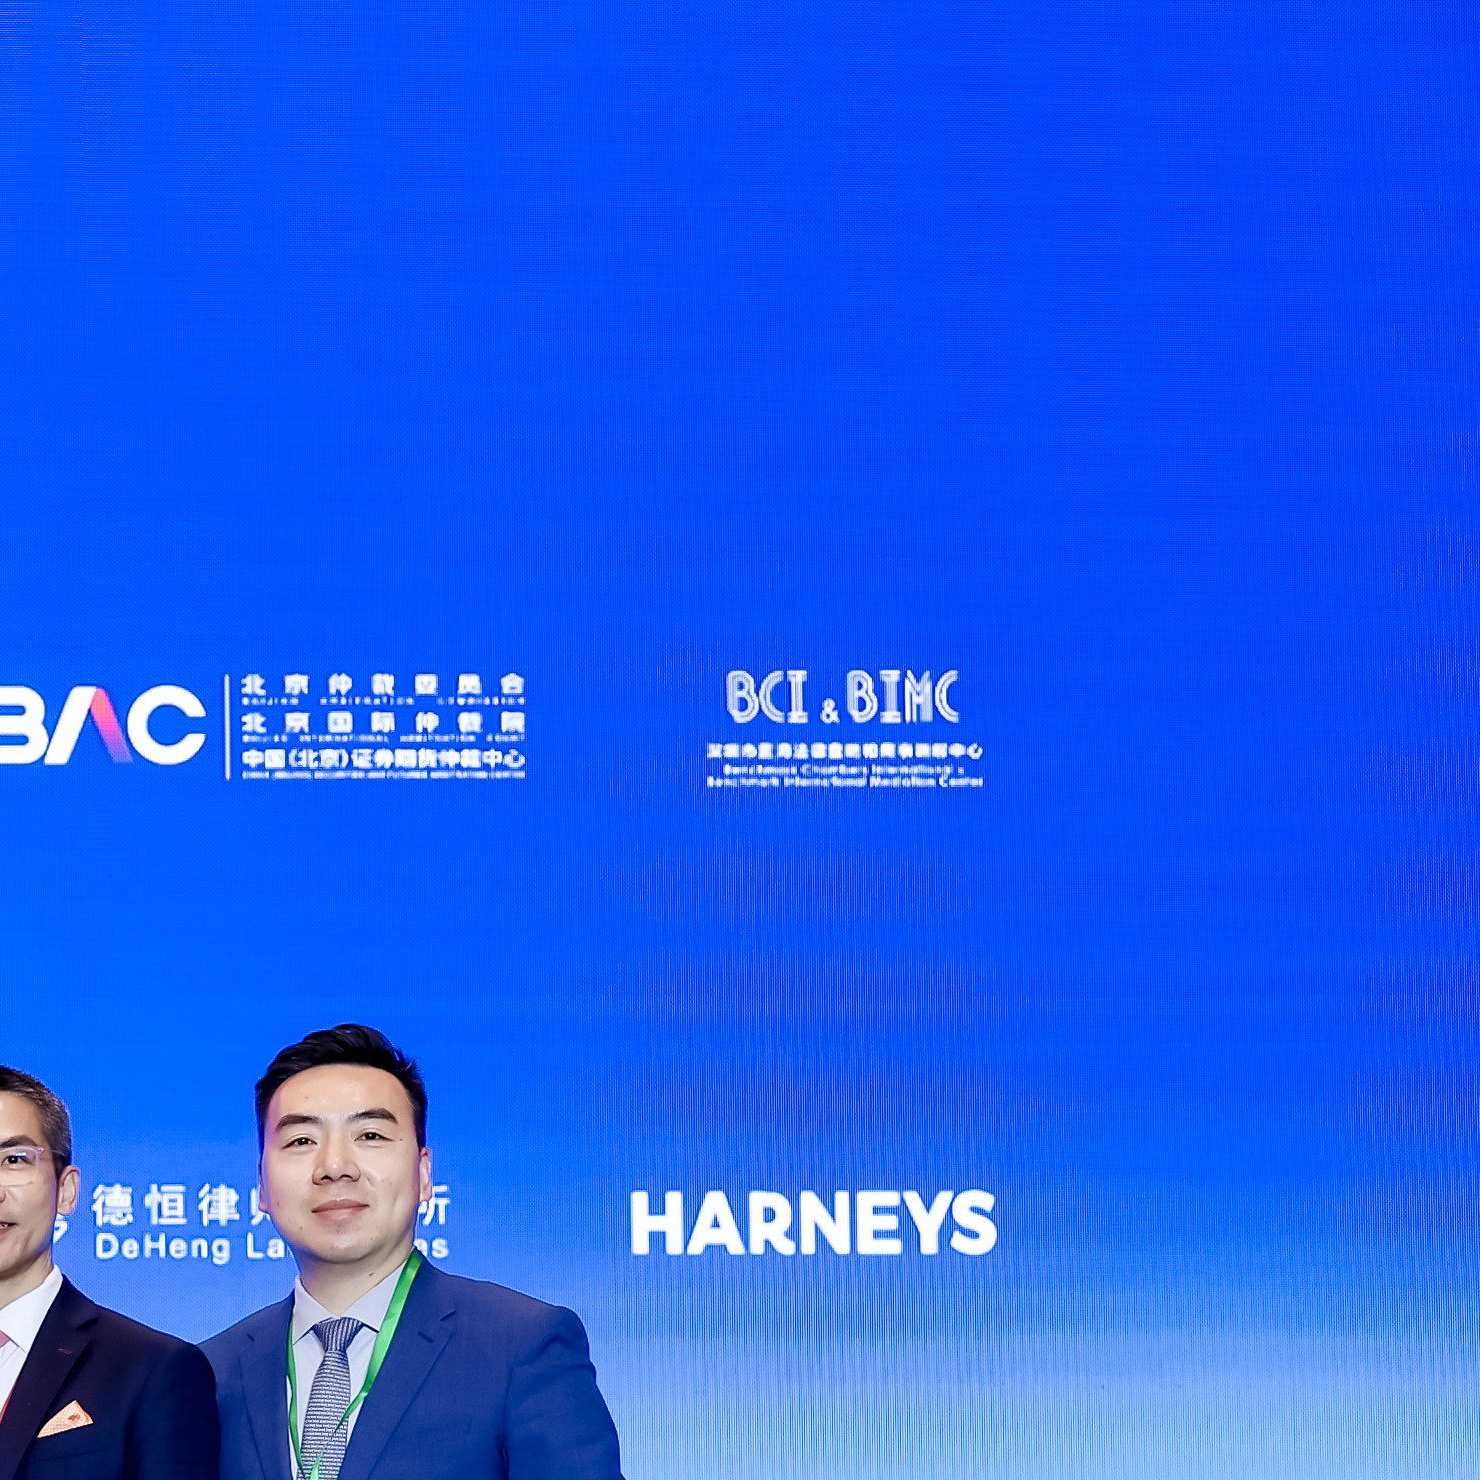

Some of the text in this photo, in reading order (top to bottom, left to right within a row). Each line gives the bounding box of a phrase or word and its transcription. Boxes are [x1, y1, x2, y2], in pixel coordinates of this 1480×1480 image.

[727, 670, 958, 723] BCI & BIMC
[96, 1233, 230, 1265] DeHeng
[631, 1190, 997, 1255] HARNEYS
